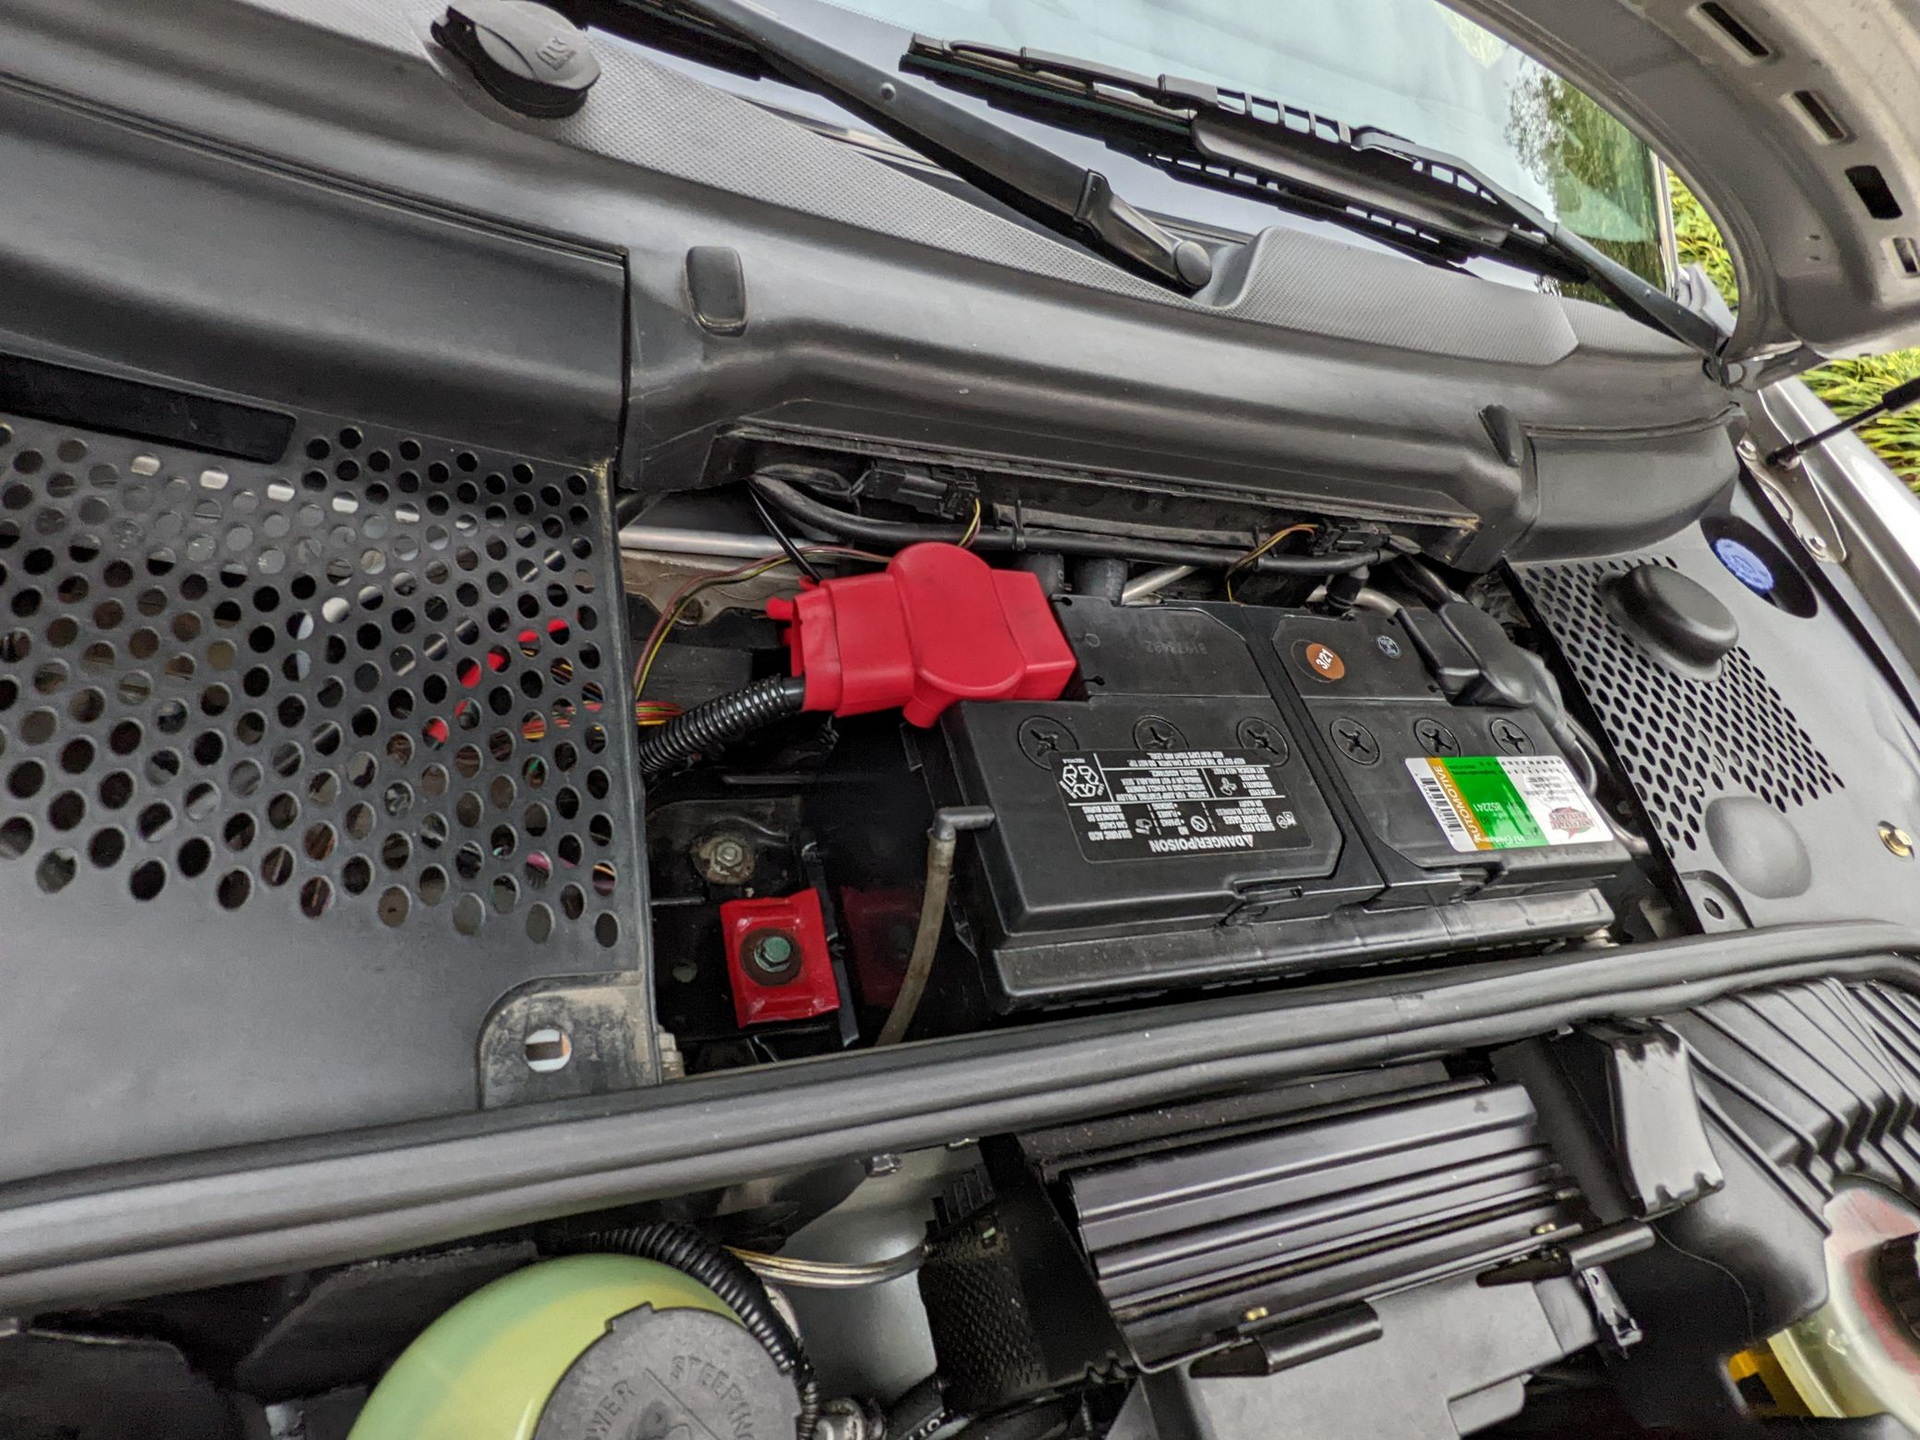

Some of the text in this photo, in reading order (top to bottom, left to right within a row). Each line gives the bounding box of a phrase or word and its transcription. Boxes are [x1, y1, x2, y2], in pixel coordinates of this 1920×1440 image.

[1315, 648, 1334, 670] 3/21
[1433, 765, 1484, 844] AUTOMOTIVE
[1149, 835, 1245, 851] DANGER/POISON
[670, 1354, 756, 1440] STEERIN
